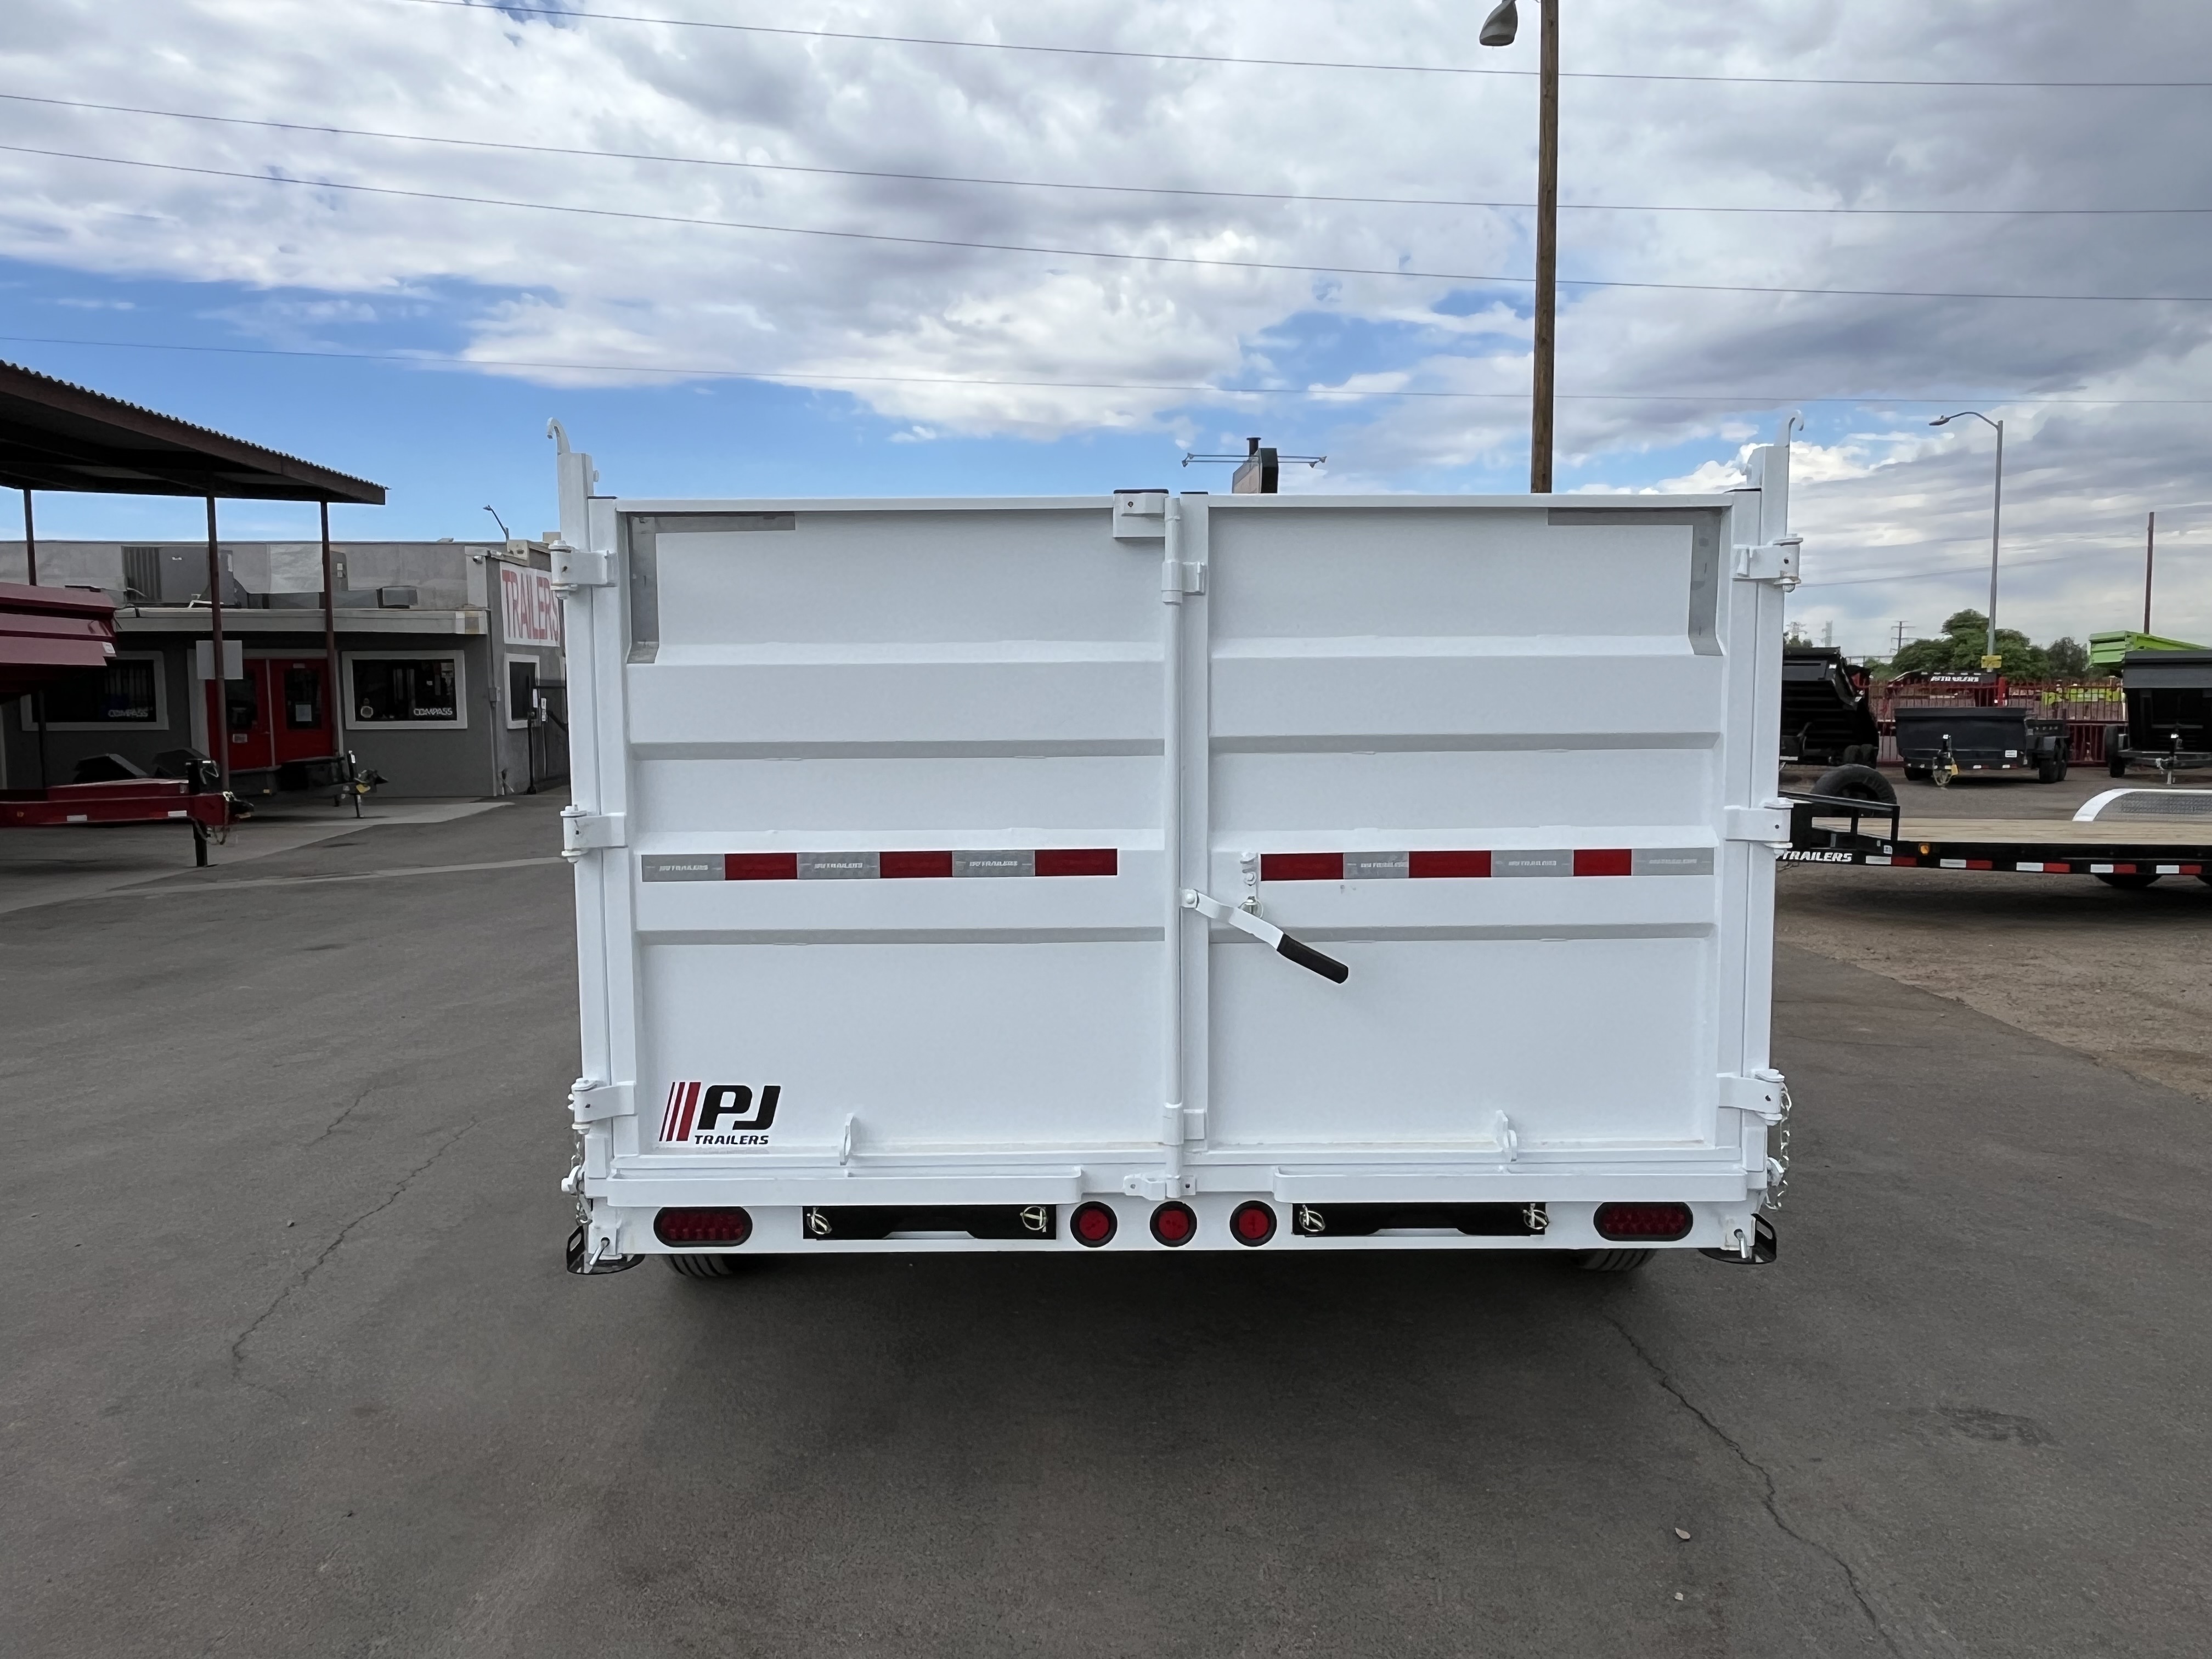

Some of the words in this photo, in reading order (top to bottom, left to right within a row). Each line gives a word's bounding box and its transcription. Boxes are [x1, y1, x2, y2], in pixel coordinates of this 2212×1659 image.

[502, 569, 559, 642] TRAILERS
[697, 1085, 781, 1130] PJ
[694, 1135, 769, 1145] TRAILERS
